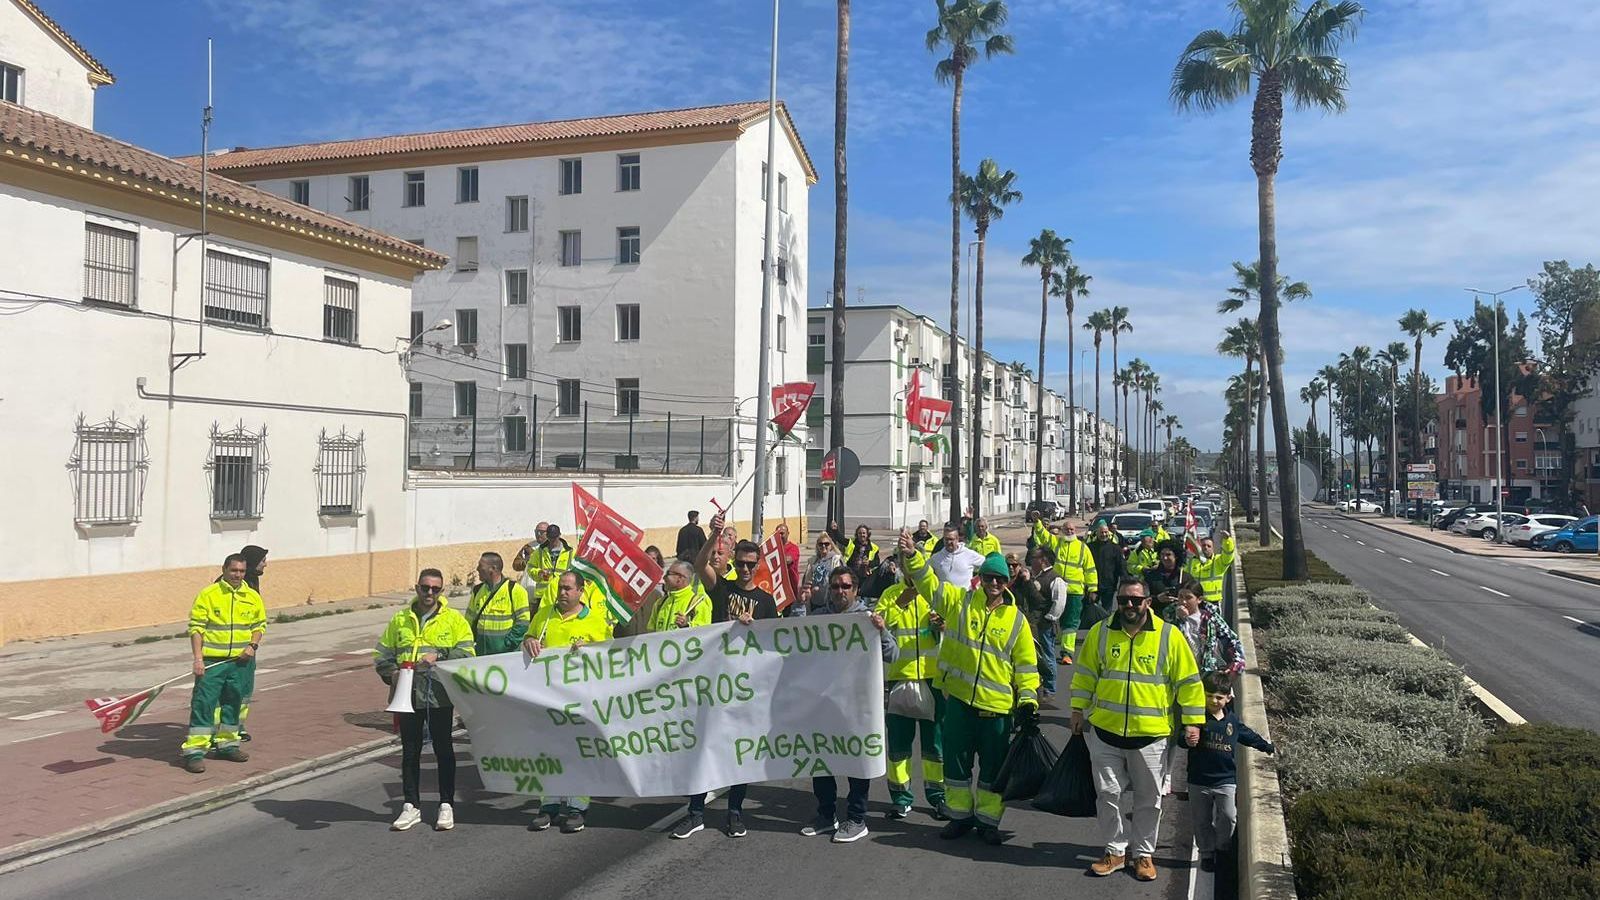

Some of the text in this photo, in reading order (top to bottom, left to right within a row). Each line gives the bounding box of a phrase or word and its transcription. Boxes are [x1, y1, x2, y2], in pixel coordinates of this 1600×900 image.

[452, 622, 868, 696] NO TENEMOS LA CULPA
[547, 672, 754, 726] DE VUESTROS
[576, 719, 697, 759] ERRORES
[735, 733, 883, 765] PAGARNOS
[480, 752, 563, 775] SOLUCIÓN
[792, 757, 832, 777] YA
[514, 775, 544, 792] YA
